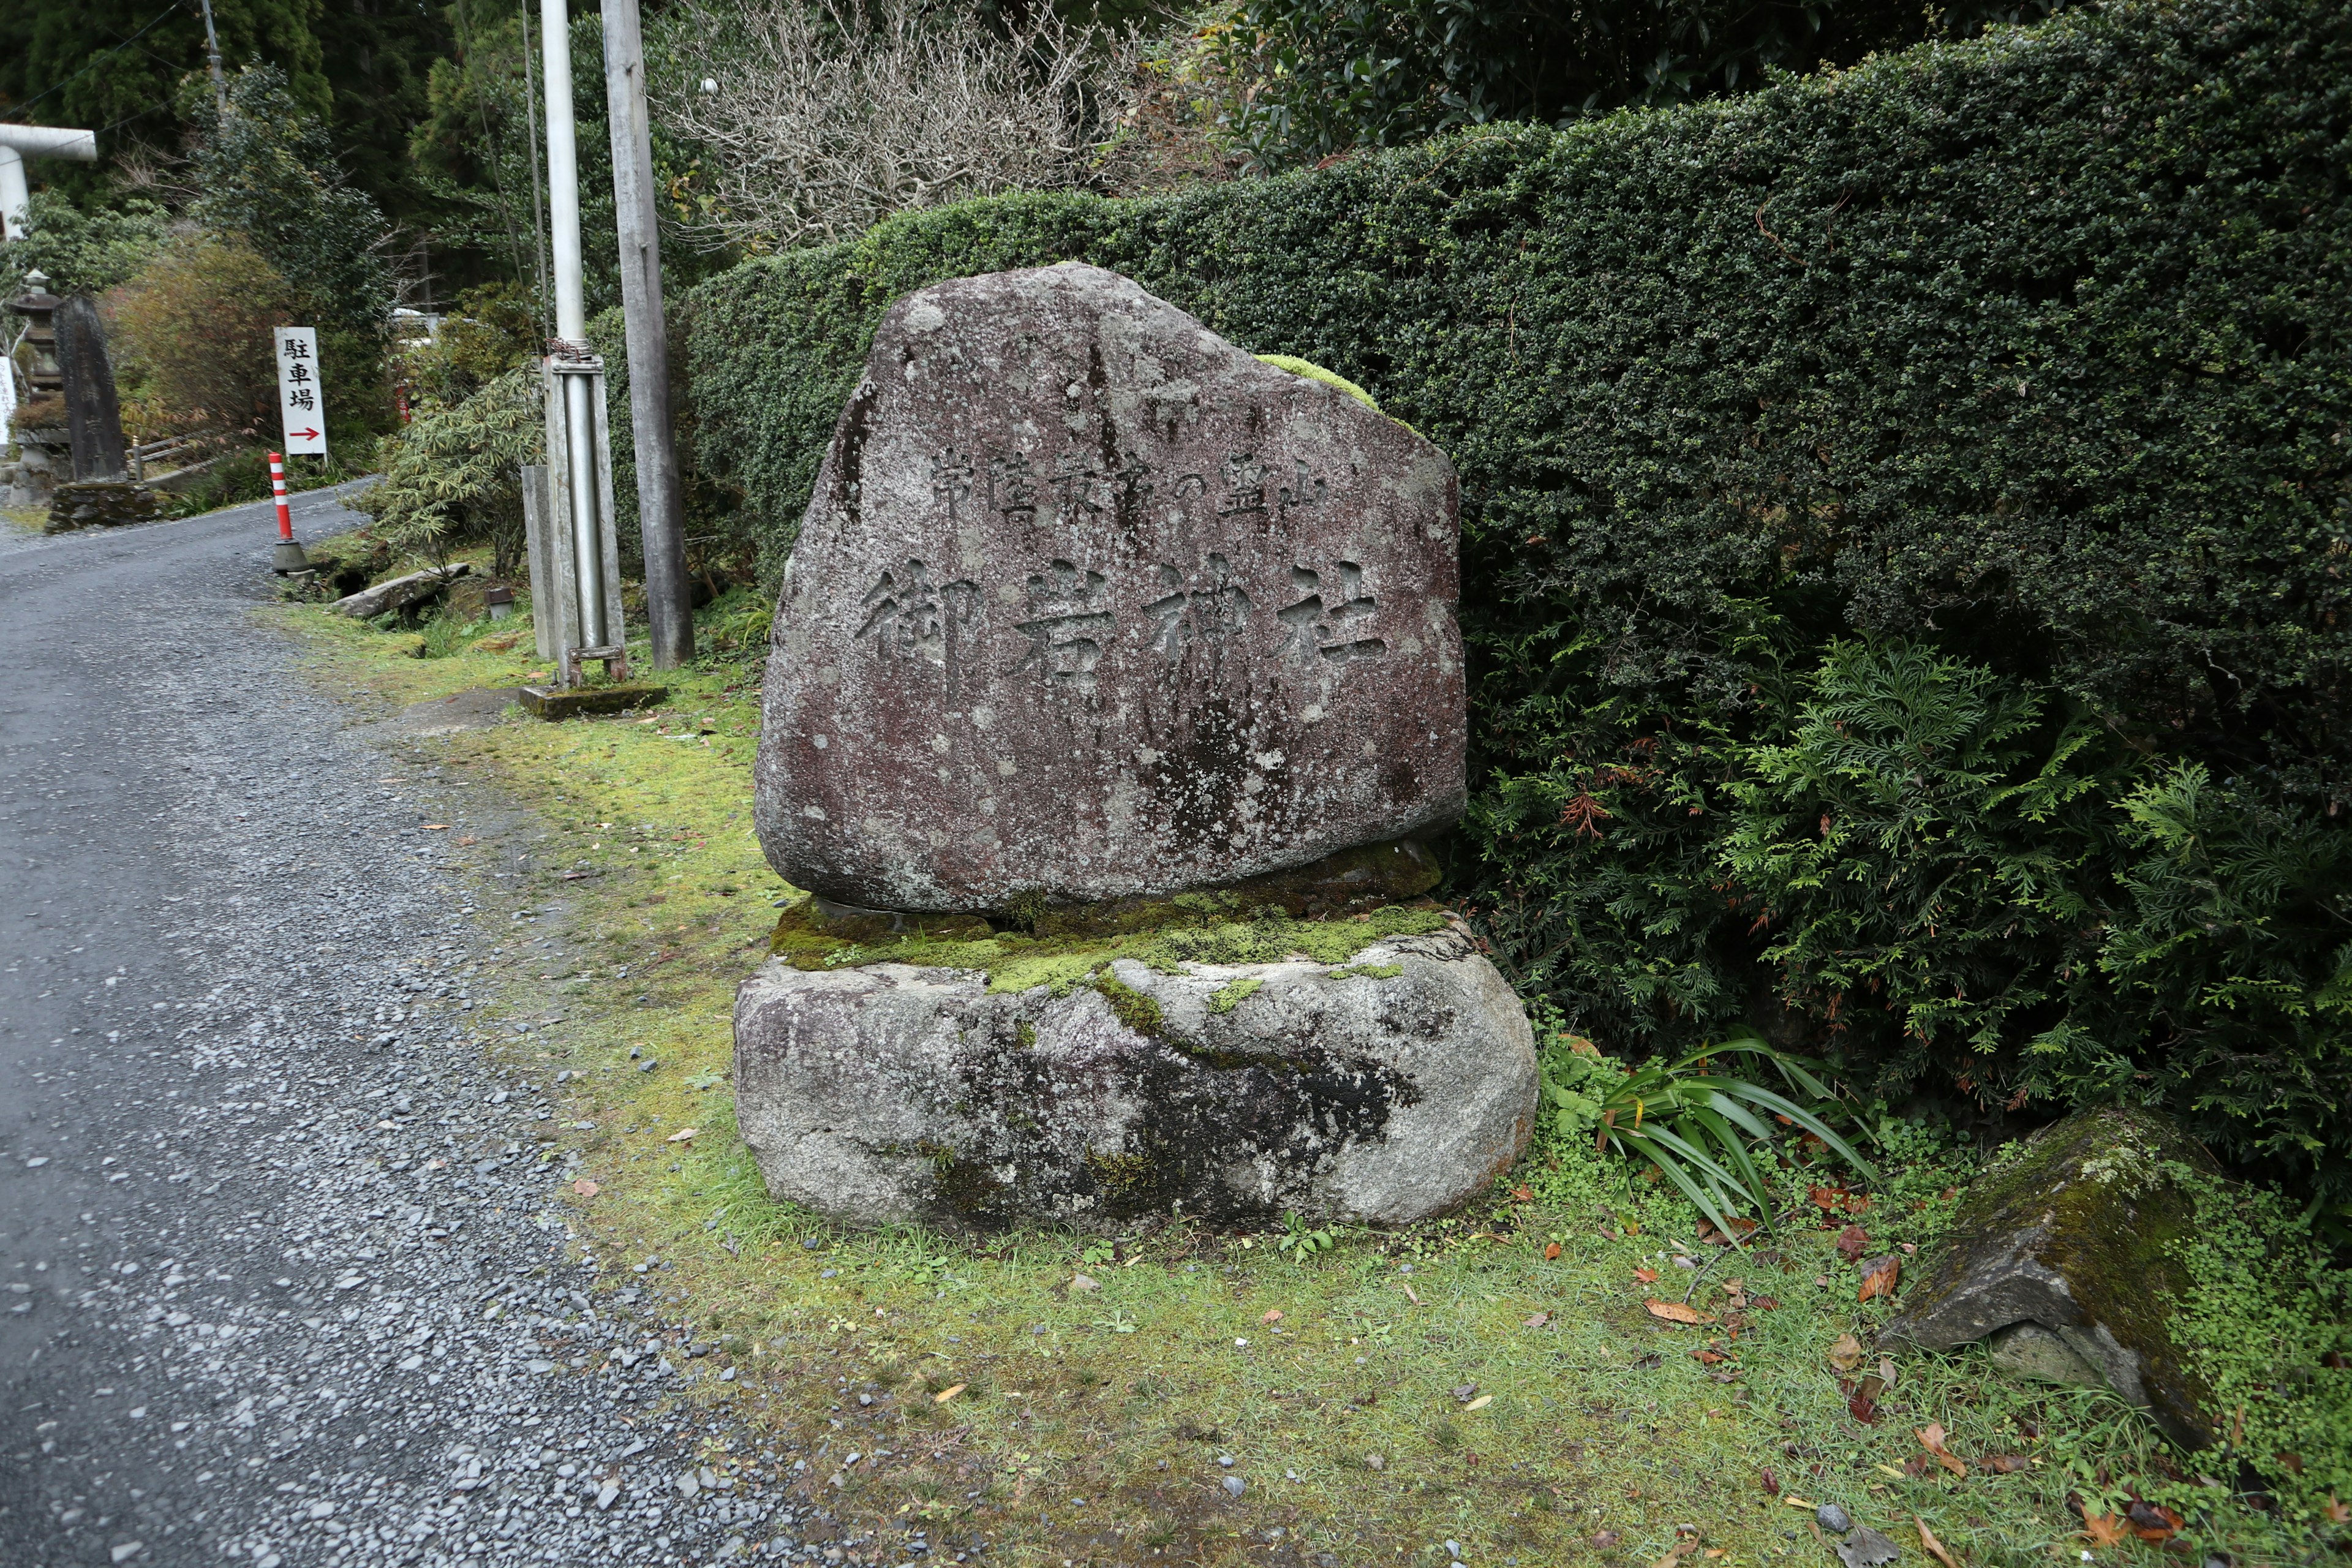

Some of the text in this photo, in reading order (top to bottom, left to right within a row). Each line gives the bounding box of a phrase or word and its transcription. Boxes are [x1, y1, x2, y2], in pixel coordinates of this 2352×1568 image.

[284, 339, 315, 411] 駐車場
[857, 552, 1387, 705] 御岩神社
